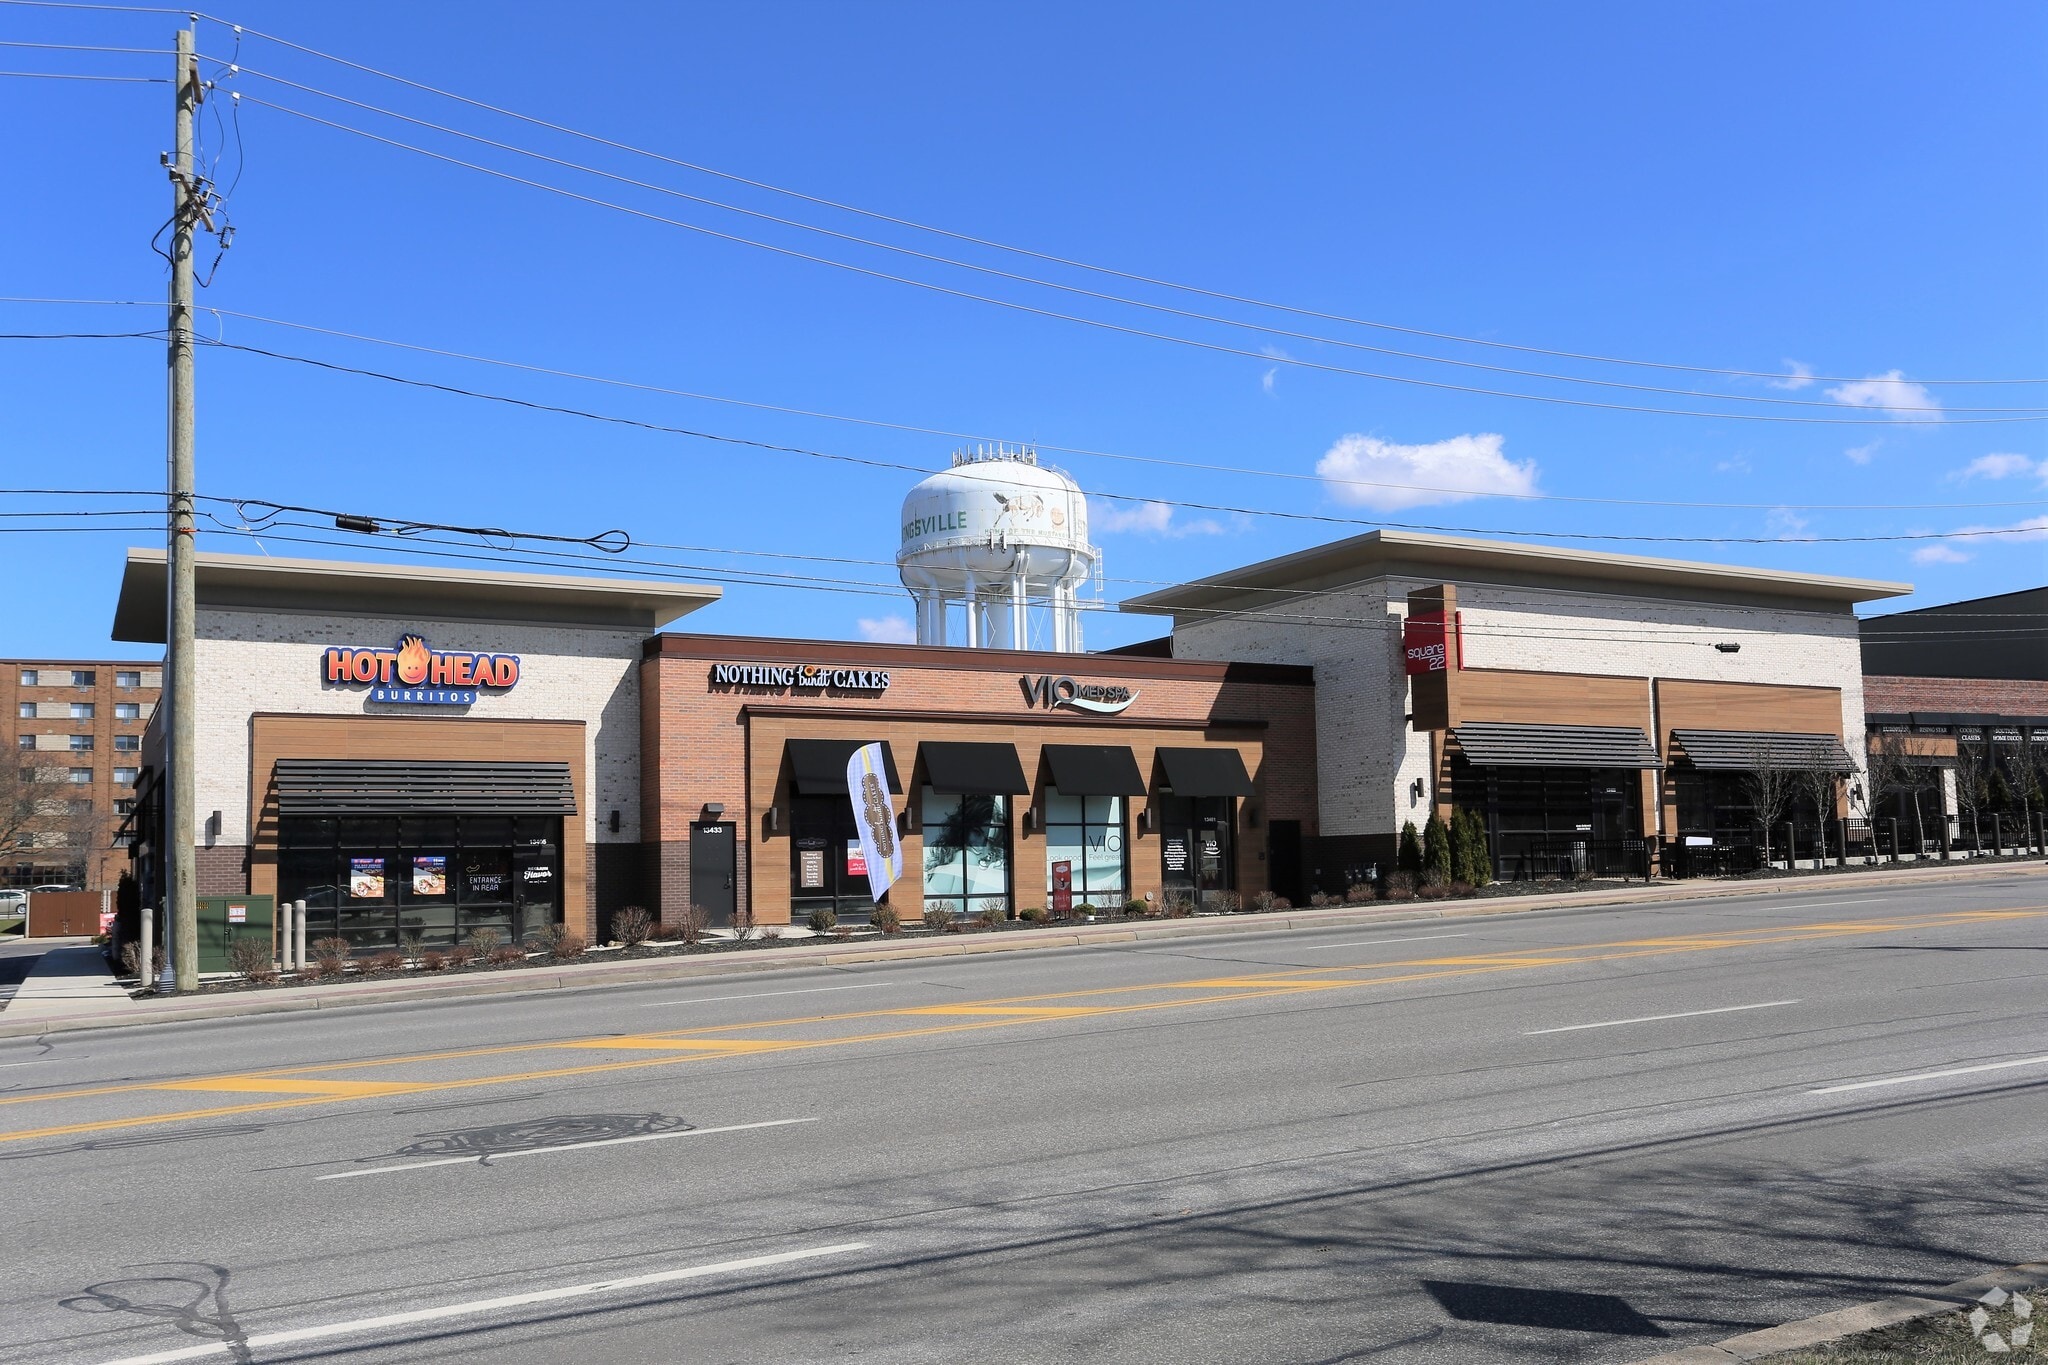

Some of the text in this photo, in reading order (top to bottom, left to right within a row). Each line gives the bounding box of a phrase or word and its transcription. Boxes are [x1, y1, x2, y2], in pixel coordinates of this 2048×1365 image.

[1407, 643, 1445, 660] square
[328, 650, 518, 687] HOT HEAD
[1429, 656, 1445, 670] 22
[715, 664, 794, 686] NOTHING
[833, 670, 891, 689] CAKES
[377, 690, 470, 702] BURRITOS
[1023, 675, 1130, 704] VIO MED SPA
[1089, 835, 1122, 852] VIO
